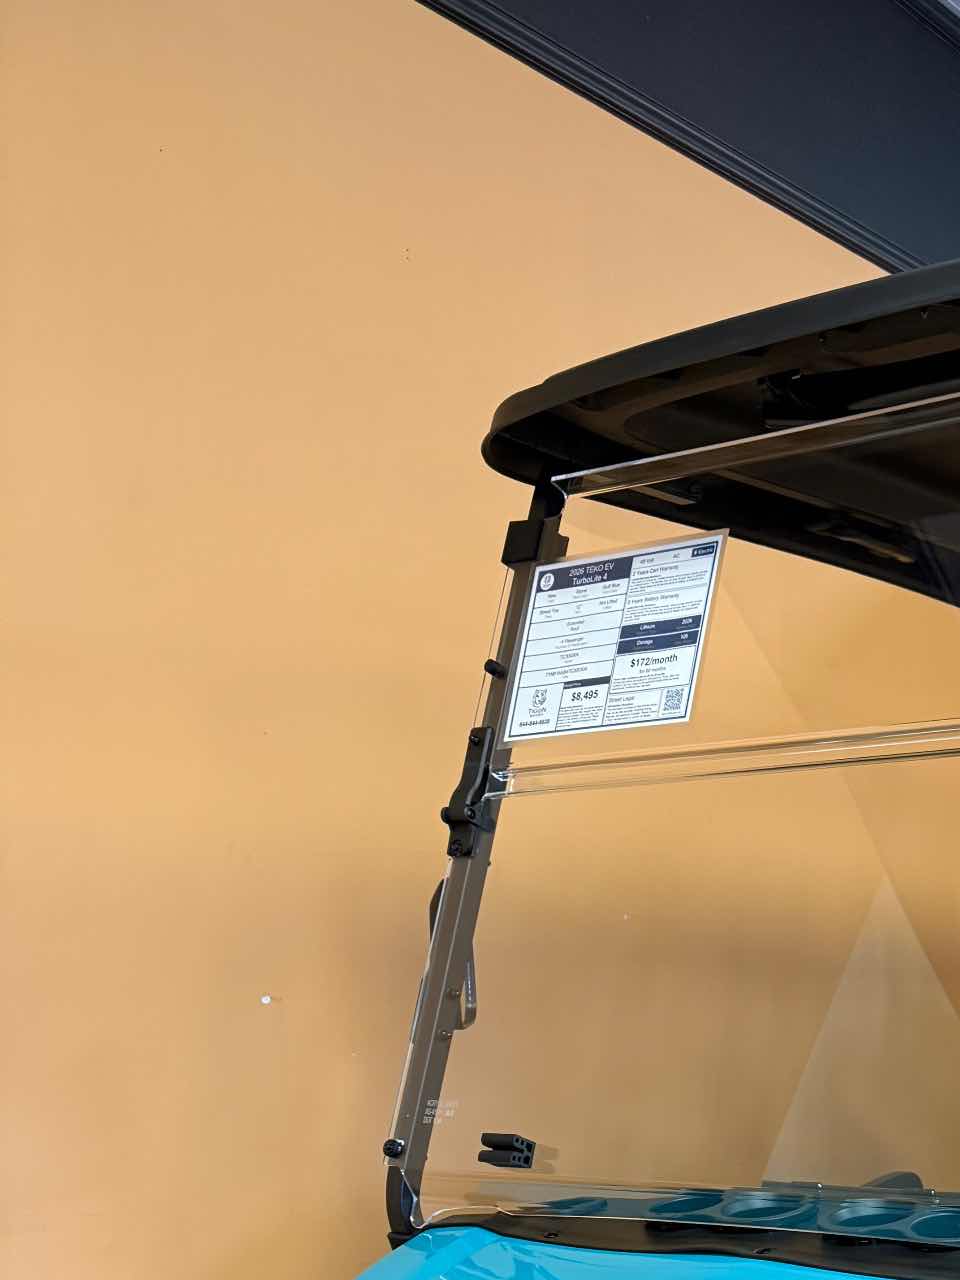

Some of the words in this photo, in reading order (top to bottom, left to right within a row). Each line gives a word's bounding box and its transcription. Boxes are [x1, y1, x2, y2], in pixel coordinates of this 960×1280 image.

[568, 567, 585, 577] 2026
[586, 564, 604, 573] TEKO
[604, 562, 615, 571] EV
[572, 574, 602, 585] TurboLite
[602, 572, 608, 580] 4
[630, 653, 678, 668] $172/month
[571, 689, 599, 702] $8,495
